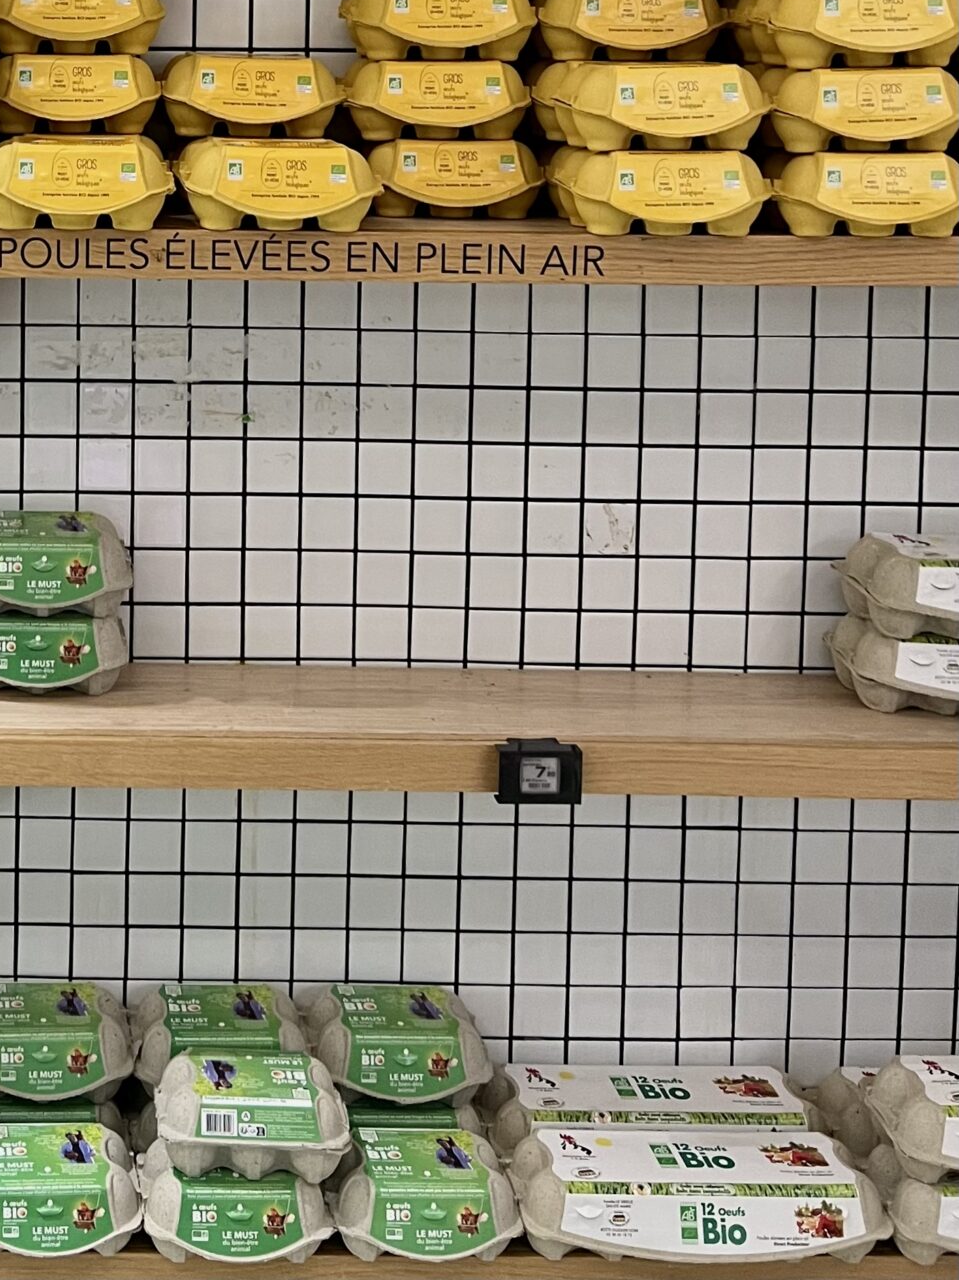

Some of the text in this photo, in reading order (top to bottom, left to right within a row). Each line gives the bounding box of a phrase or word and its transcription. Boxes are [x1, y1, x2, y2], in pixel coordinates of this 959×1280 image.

[162, 230, 333, 272] ÉLEVÉES
[347, 242, 398, 273] EN
[417, 243, 525, 274] PLEIN
[540, 245, 604, 276] AIR
[536, 766, 546, 778] 7
[637, 1084, 690, 1100] Bio
[672, 1143, 691, 1151] 12
[678, 1151, 735, 1169] Bio
[386, 1210, 411, 1221] BIO
[701, 1203, 745, 1216] 12 Oeufs
[416, 1229, 452, 1239] LE MUST
[702, 1218, 747, 1245] Bio
